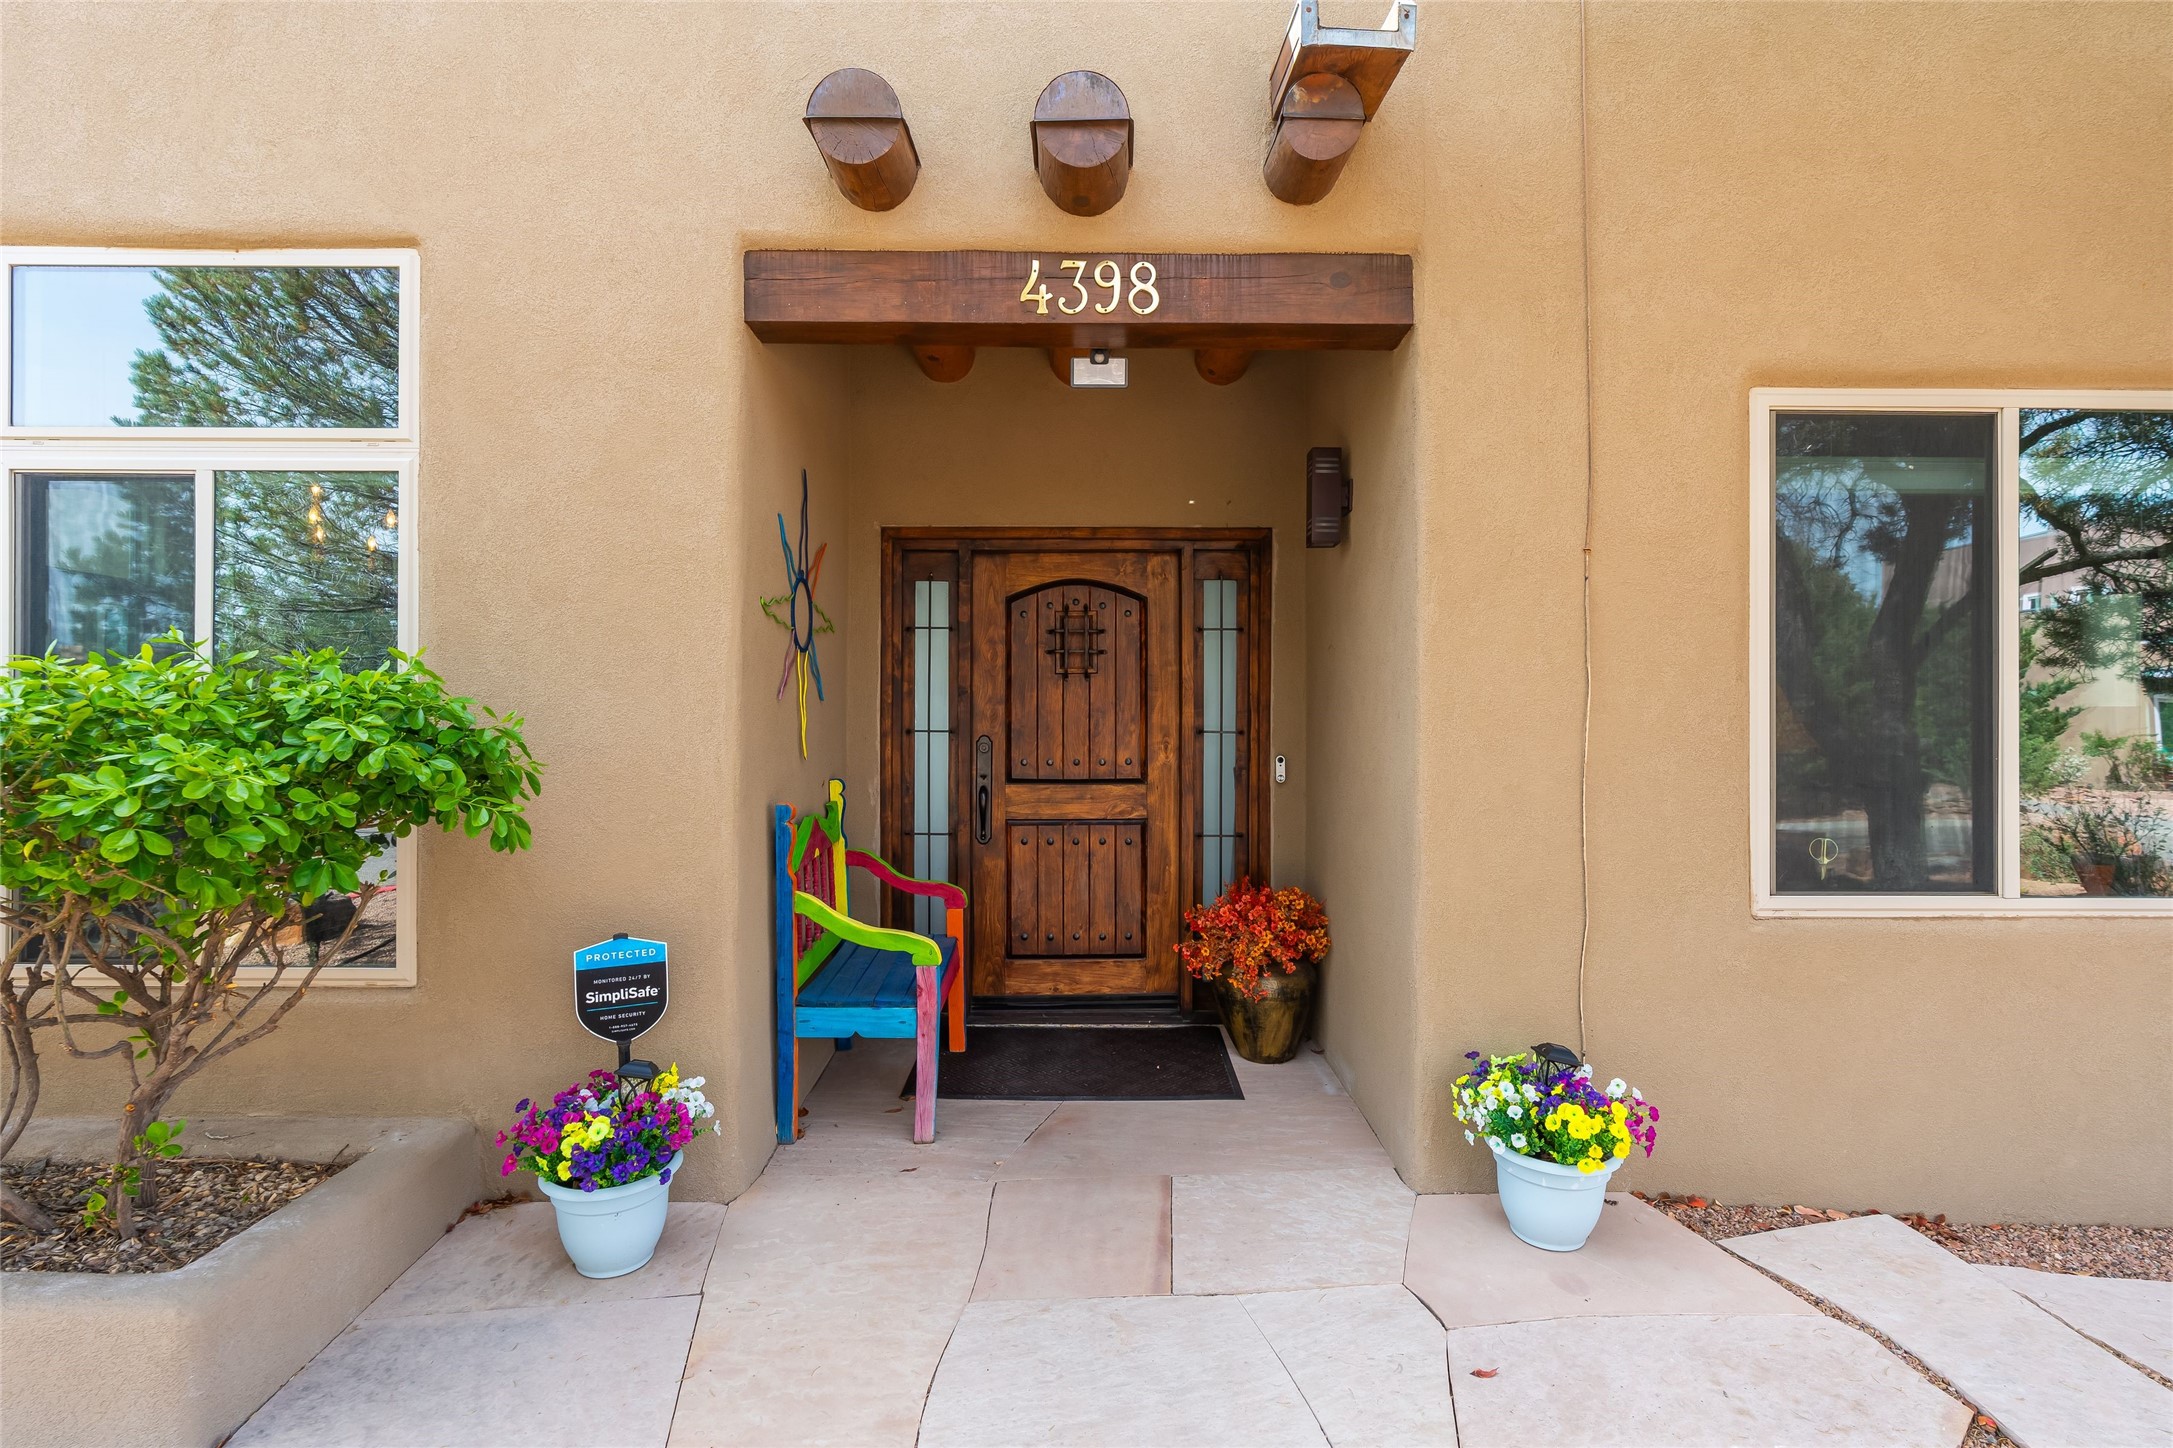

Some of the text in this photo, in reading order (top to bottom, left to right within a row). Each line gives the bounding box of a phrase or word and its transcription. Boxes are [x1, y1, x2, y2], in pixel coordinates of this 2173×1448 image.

[1020, 259, 1160, 315] 4398
[586, 948, 656, 962] PROTECTED
[593, 976, 627, 985] MONITORED
[585, 986, 659, 1003] SimpliSafe
[618, 1011, 646, 1019] SECURITY
